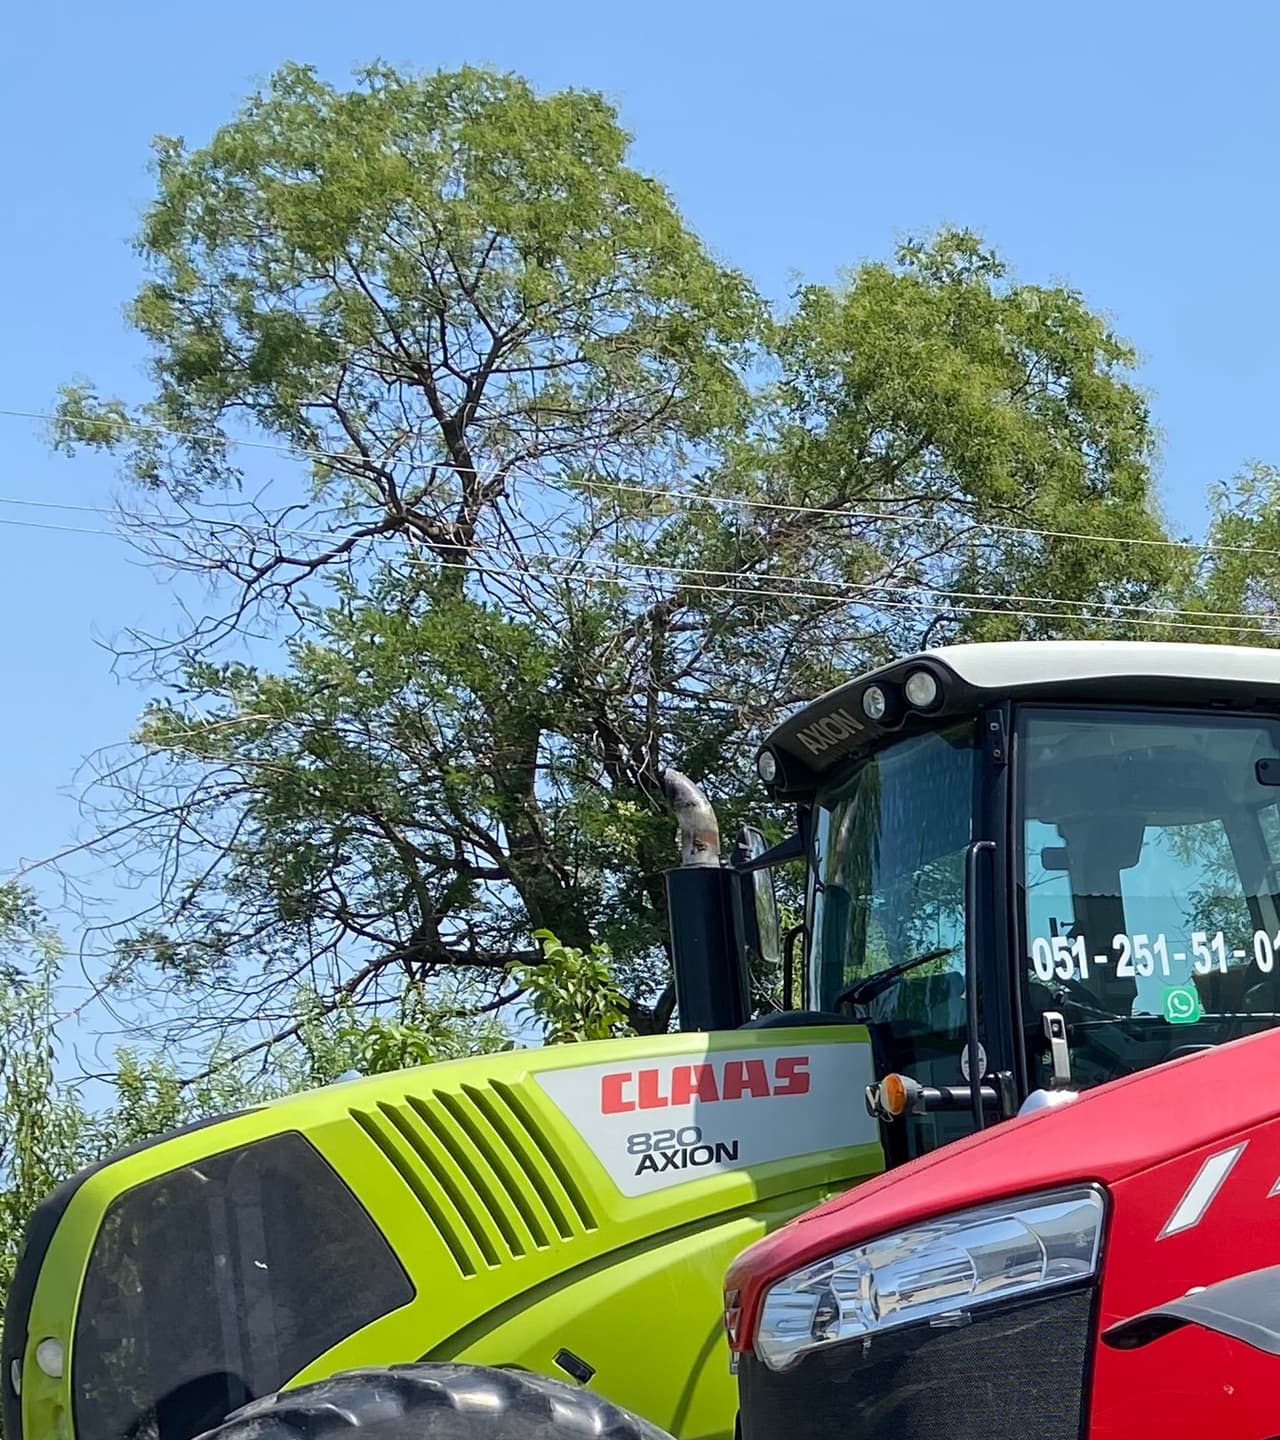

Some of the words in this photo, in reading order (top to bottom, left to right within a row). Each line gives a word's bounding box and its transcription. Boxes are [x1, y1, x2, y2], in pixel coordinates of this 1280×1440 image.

[796, 708, 865, 755] AXION
[601, 1056, 810, 1115] CLAAS
[626, 1126, 702, 1156] 820
[634, 1141, 738, 1176] AXION
